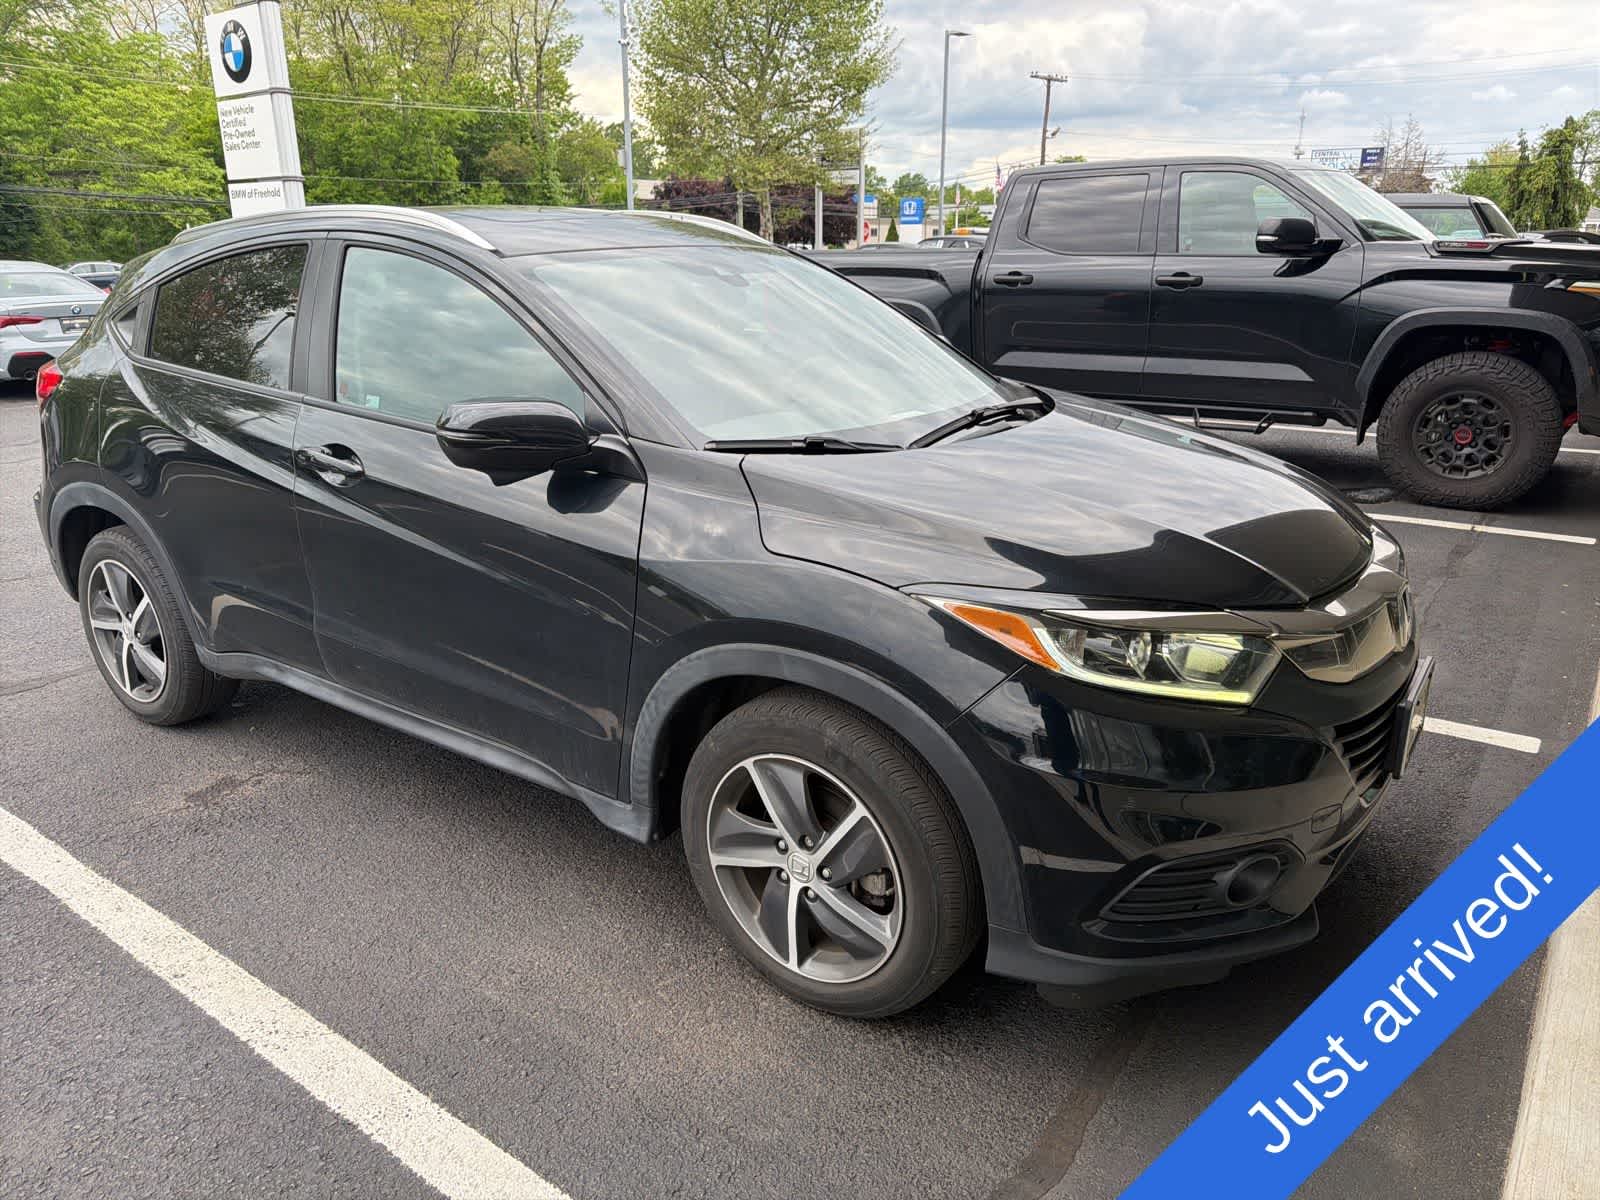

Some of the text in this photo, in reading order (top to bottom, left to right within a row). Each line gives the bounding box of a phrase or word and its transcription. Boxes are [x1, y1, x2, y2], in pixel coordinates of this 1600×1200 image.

[232, 103, 255, 115] Vehicle
[221, 116, 246, 129] Certified
[223, 127, 256, 140] Pre-Owned
[224, 139, 261, 152] Sales Center
[231, 186, 281, 200] BMW of Freehold
